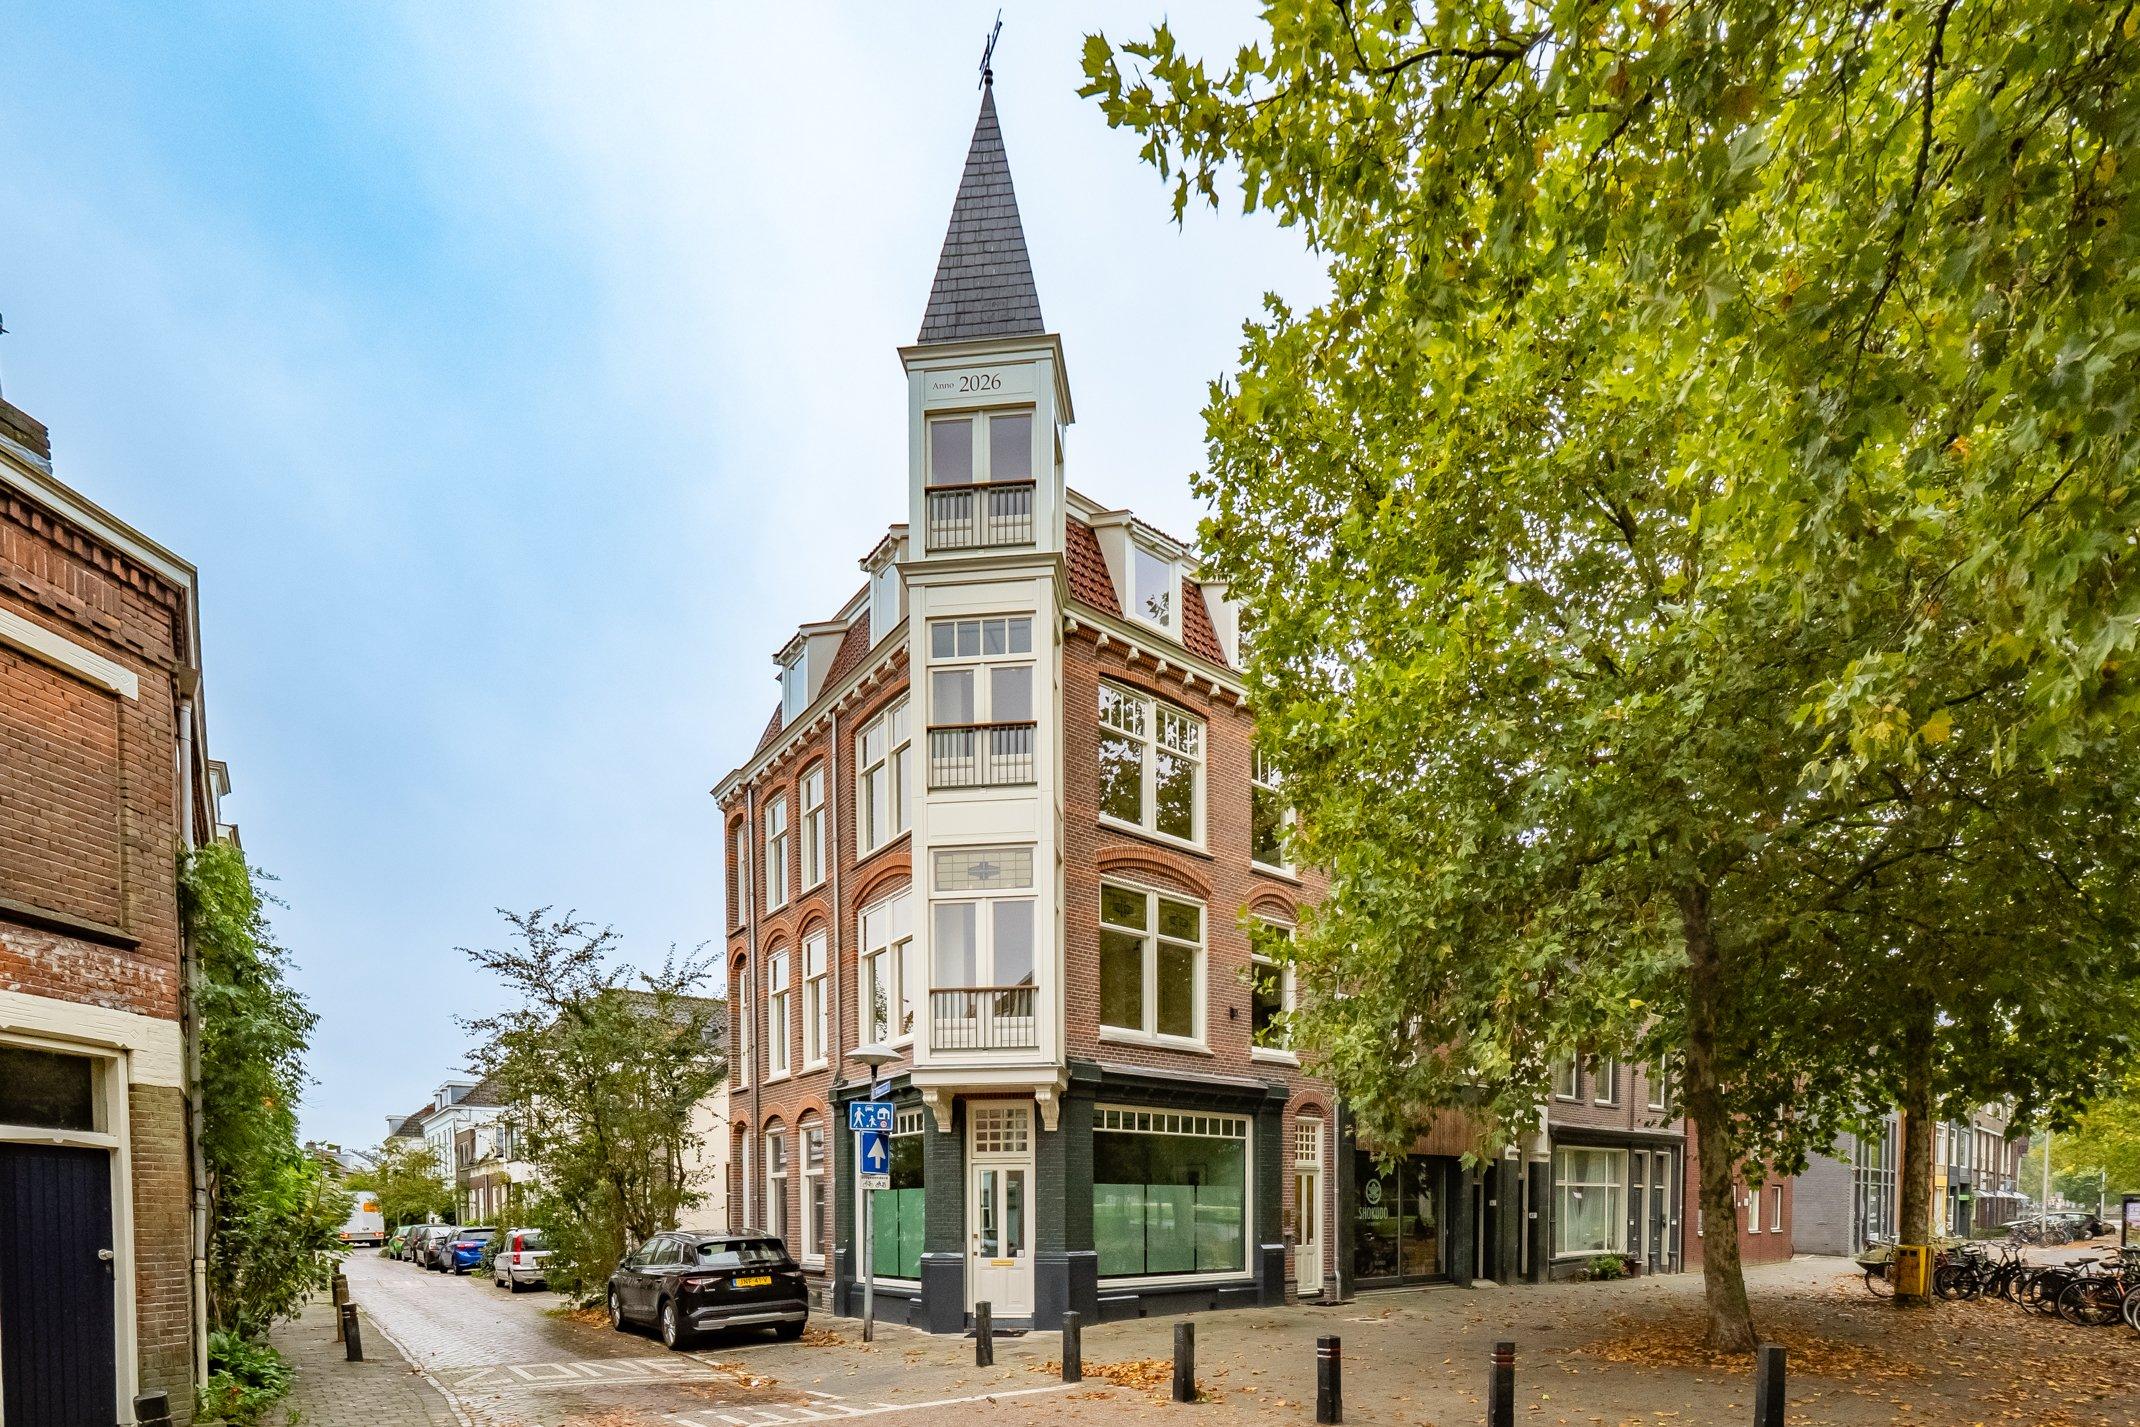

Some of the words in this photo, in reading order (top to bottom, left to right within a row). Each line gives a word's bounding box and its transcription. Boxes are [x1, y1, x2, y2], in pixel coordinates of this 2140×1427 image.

[932, 382, 954, 390] Anno
[959, 373, 1001, 392] 2026
[1359, 1206, 1388, 1219] SHOKUDO
